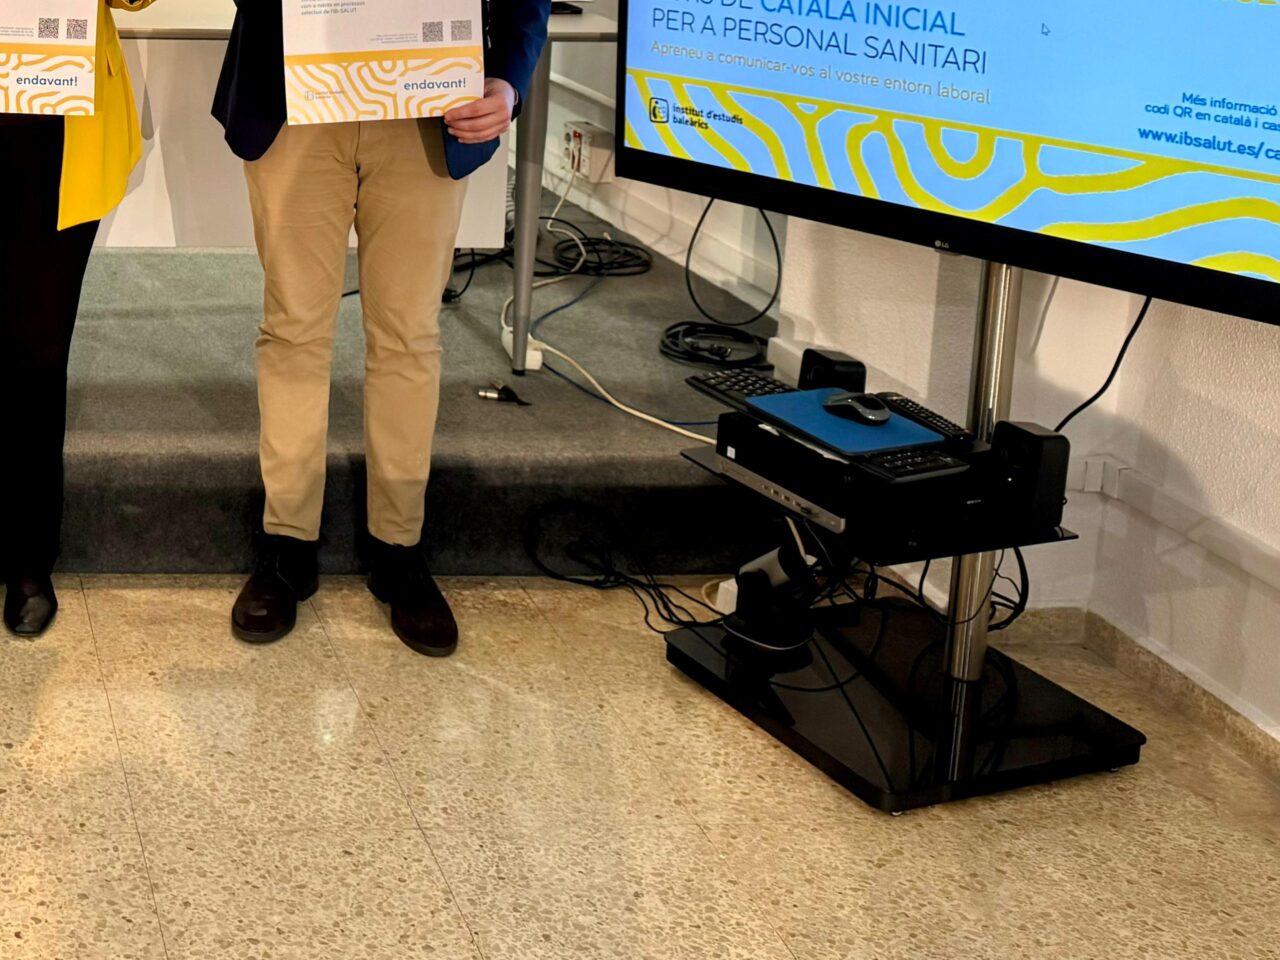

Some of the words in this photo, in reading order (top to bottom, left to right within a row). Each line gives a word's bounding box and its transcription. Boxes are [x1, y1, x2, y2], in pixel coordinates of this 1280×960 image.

[865, 2, 966, 37] INICIAL
[652, 8, 694, 33] PER
[700, 15, 717, 36] A
[723, 17, 857, 57] PERSONAL
[864, 36, 987, 74] SANITARI
[16, 75, 78, 87] endavant!
[650, 40, 703, 60] Apreneu
[706, 50, 714, 62] a
[718, 52, 815, 78] comunicar-vos
[819, 65, 832, 79] al
[835, 70, 879, 88] vostre
[883, 76, 932, 95] entorn
[937, 81, 991, 104] laboral
[404, 78, 467, 91] endavant!
[1145, 104, 1169, 115] codi
[1173, 105, 1192, 119] QR
[1195, 112, 1211, 121] en
[1214, 114, 1252, 128] català
[1182, 92, 1207, 106] Més
[1210, 97, 1278, 116] informació
